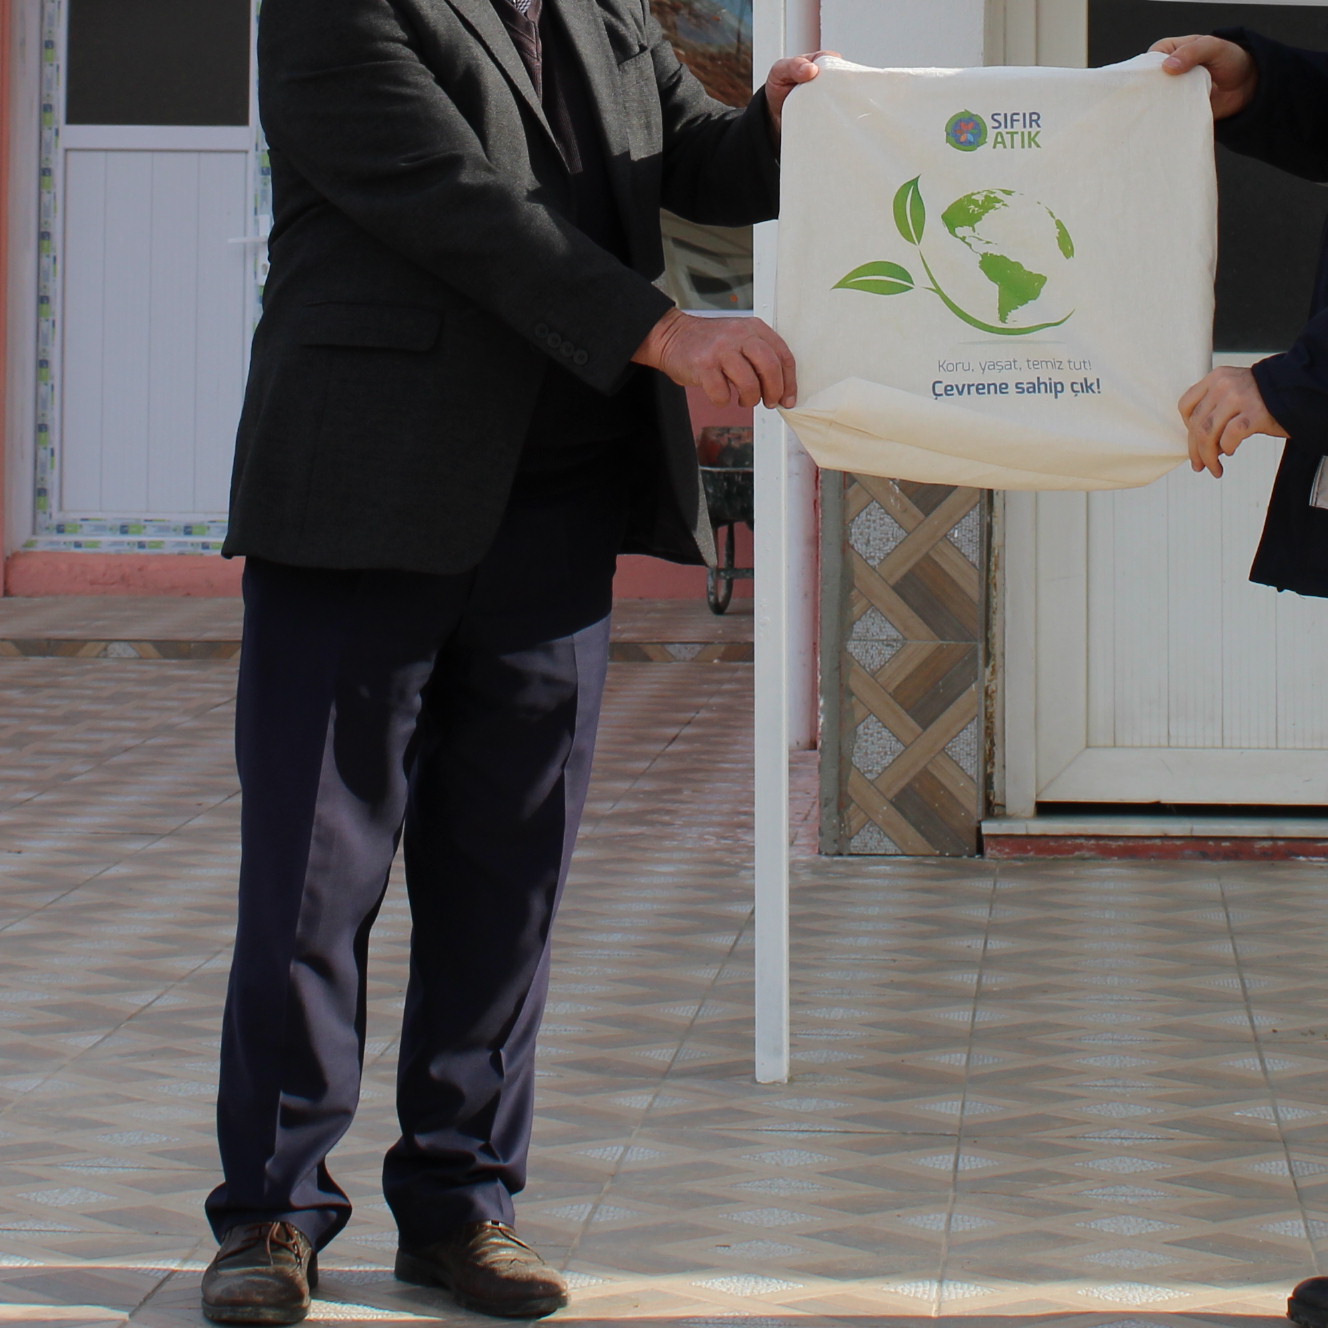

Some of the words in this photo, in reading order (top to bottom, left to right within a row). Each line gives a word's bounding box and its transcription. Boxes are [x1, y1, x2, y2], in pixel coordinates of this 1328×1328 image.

[990, 111, 1042, 130] SIFIR
[992, 130, 1042, 149] ATIK
[937, 359, 974, 373] Koru,
[978, 357, 1022, 375] yaşat,
[1026, 357, 1063, 371] temiz
[1067, 358, 1093, 371] tut!
[931, 380, 1009, 401] Çevrene
[1014, 376, 1065, 400] sahip
[1070, 377, 1102, 398] çık!
